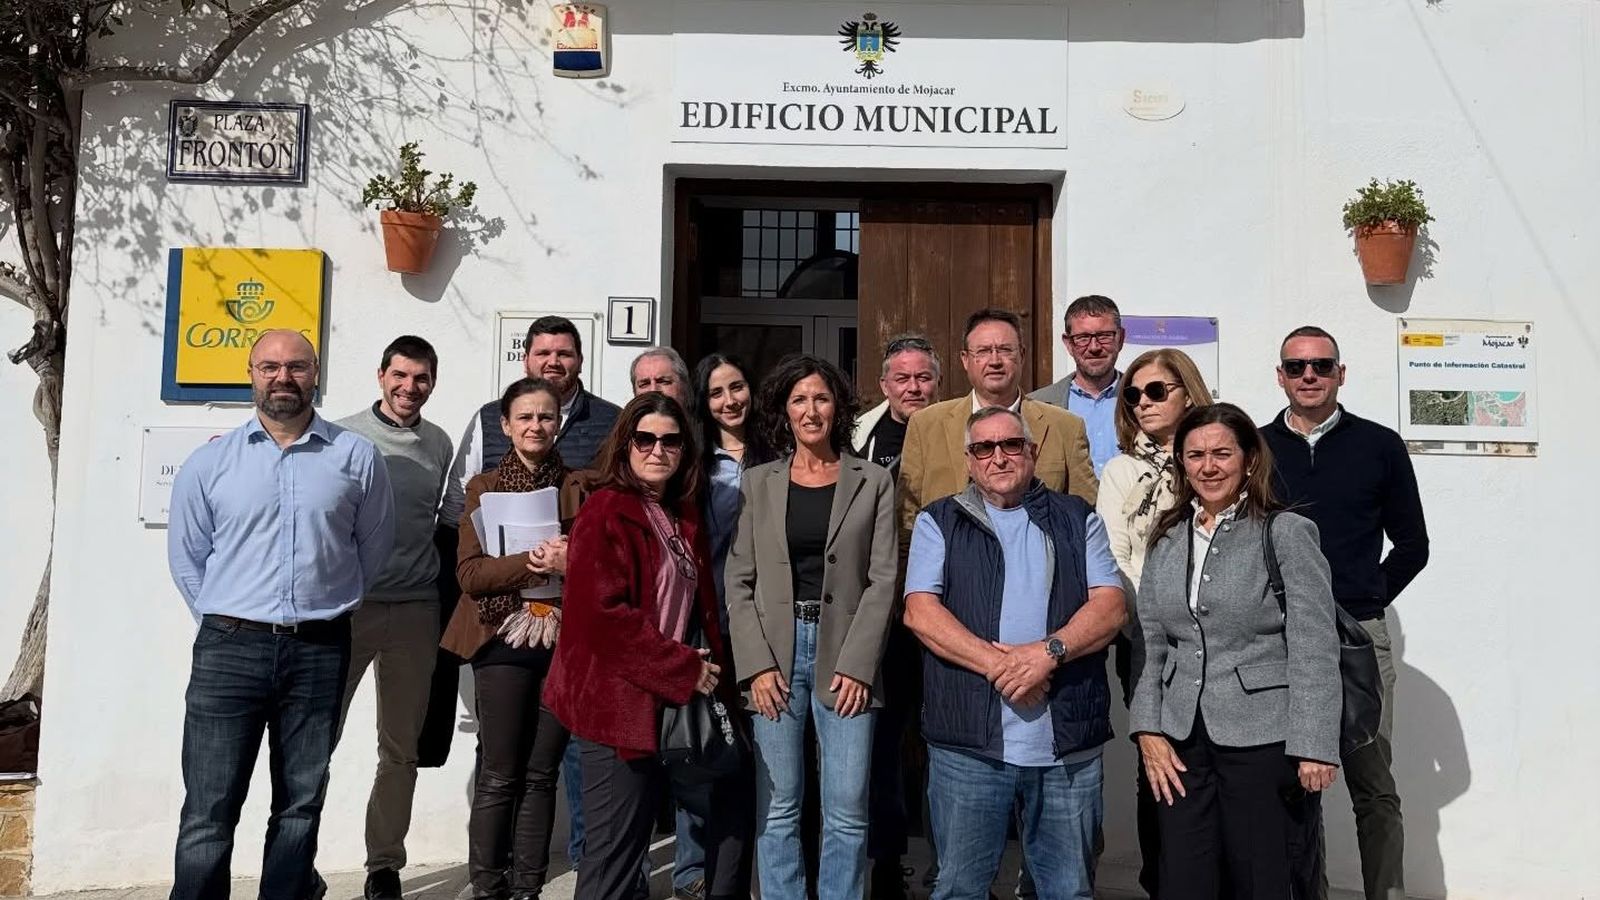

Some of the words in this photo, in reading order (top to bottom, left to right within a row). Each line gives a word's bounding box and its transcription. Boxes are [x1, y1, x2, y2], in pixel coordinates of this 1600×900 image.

[783, 82, 820, 93] Excmo.
[823, 83, 895, 96] Ayuntamiento
[898, 84, 910, 95] de
[913, 84, 956, 97] Mojacar
[213, 113, 266, 132] PLAZA
[679, 101, 845, 132] EDIFICIO
[854, 104, 1058, 134] MUNICIPAL
[179, 134, 294, 168] FRONTÓN
[624, 306, 636, 334] 1
[186, 322, 312, 348] CORR
[1445, 361, 1490, 369] Información
[1491, 362, 1526, 370] Catastral
